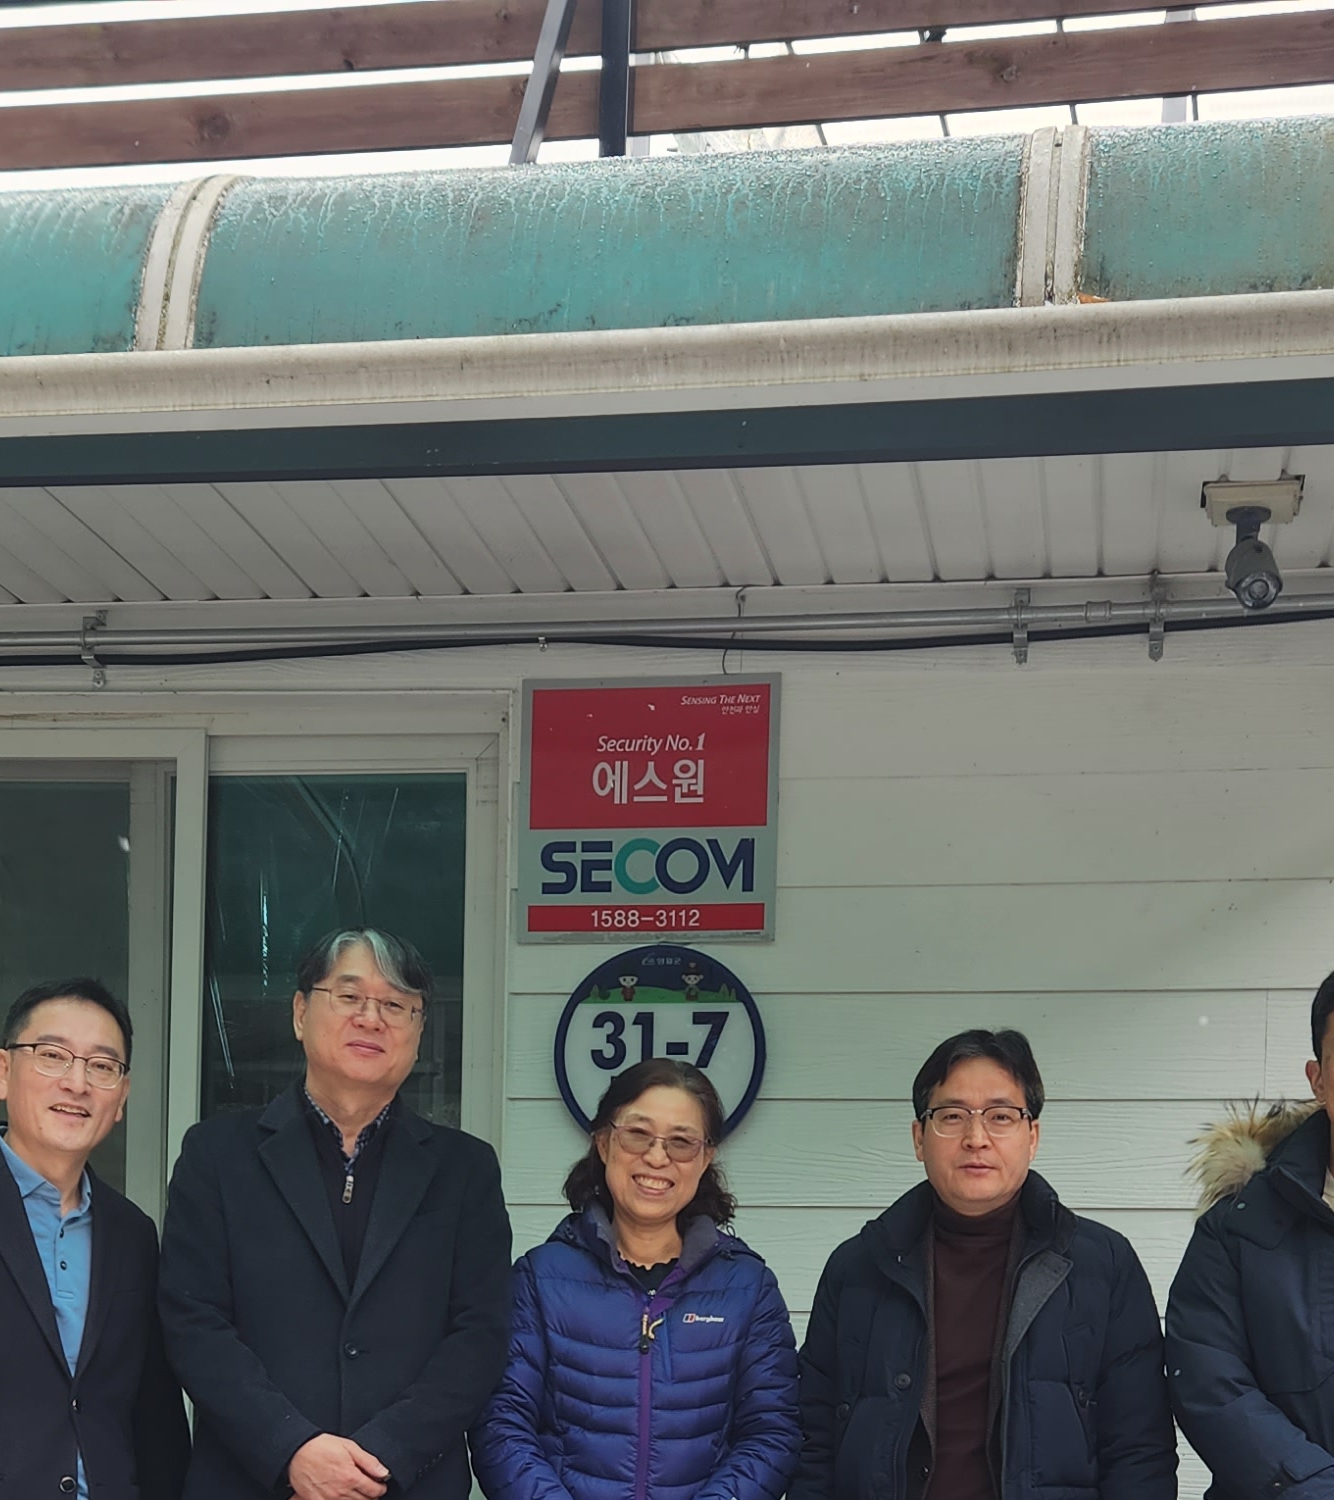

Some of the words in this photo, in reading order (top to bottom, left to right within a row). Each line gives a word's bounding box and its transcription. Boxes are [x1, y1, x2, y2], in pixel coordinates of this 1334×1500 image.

[719, 694, 736, 704] THE
[737, 693, 761, 704] NEXT
[597, 735, 663, 756] Security
[665, 732, 706, 751] No.1
[592, 759, 705, 804] 에스원
[540, 837, 756, 895] SECOM
[591, 909, 700, 928] 1588-3112
[590, 1010, 730, 1071] 31-7
